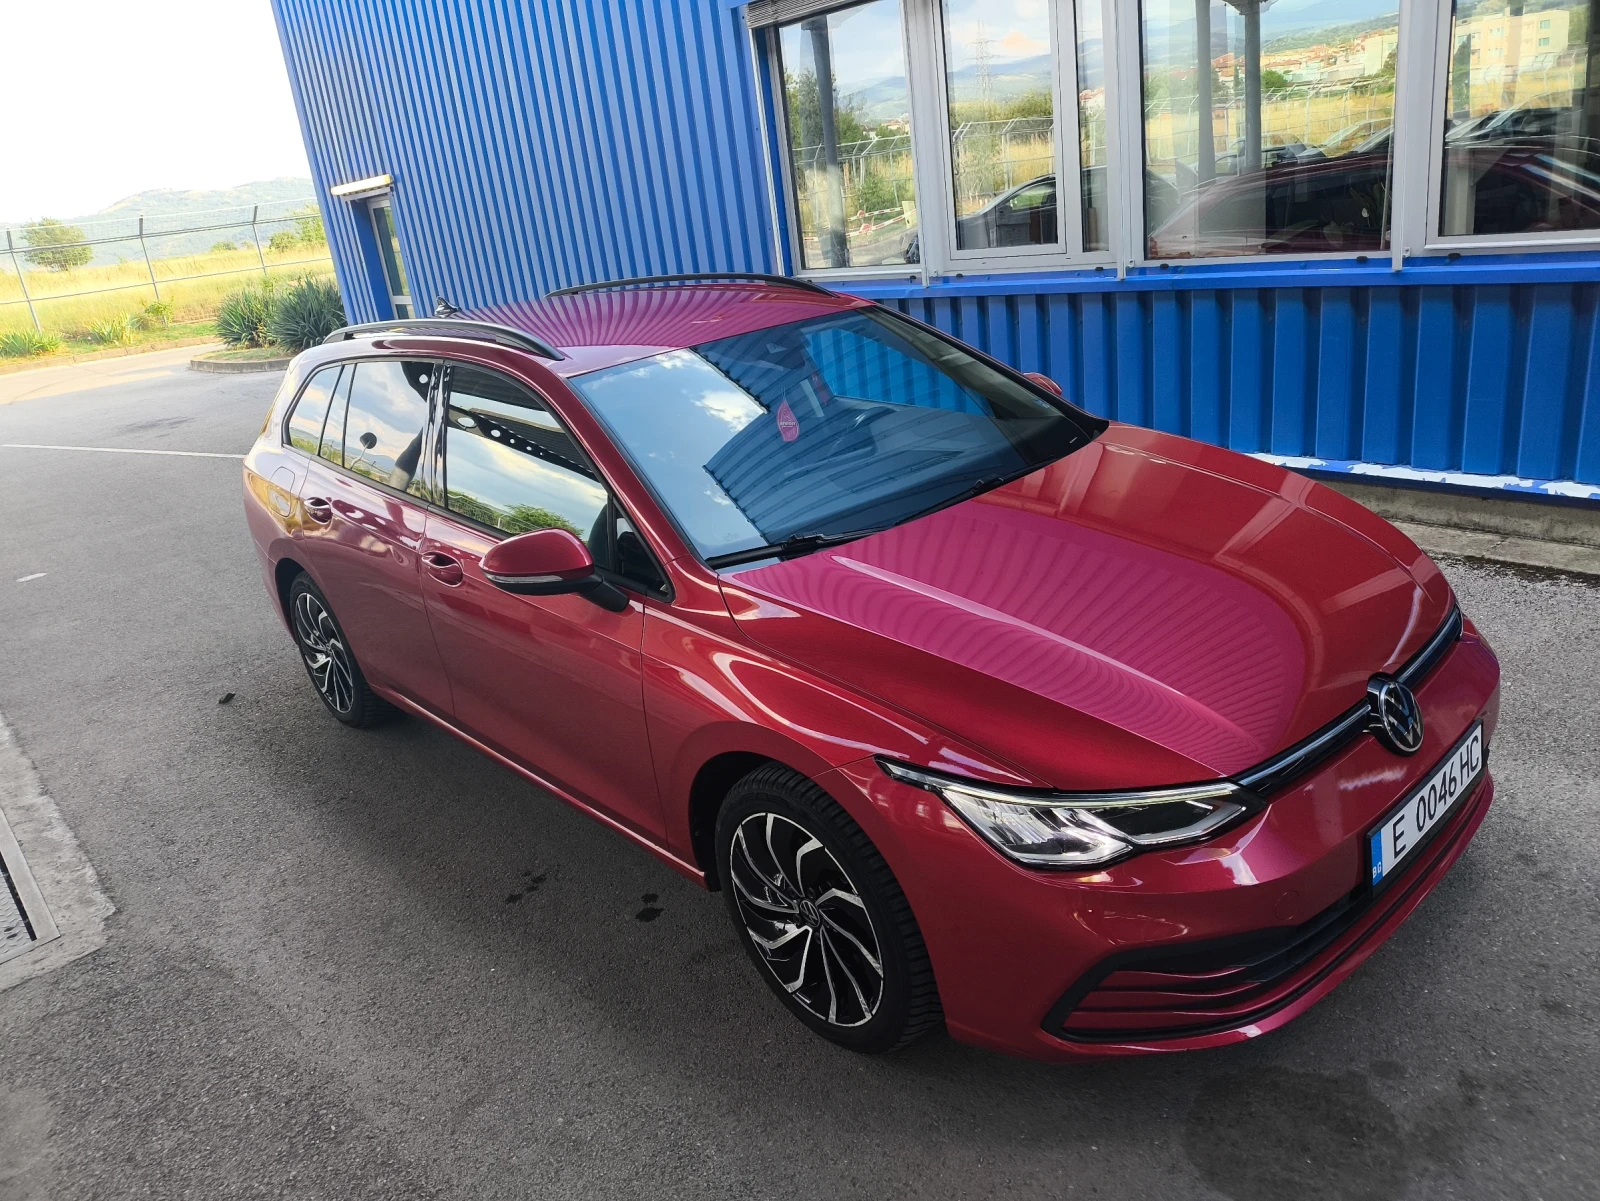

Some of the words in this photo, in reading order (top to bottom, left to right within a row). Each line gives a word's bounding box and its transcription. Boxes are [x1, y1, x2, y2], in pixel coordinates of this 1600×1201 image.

[1392, 814, 1406, 860] E
[1416, 760, 1457, 832] 0046
[1460, 734, 1479, 786] HC
[1372, 861, 1382, 879] BG
